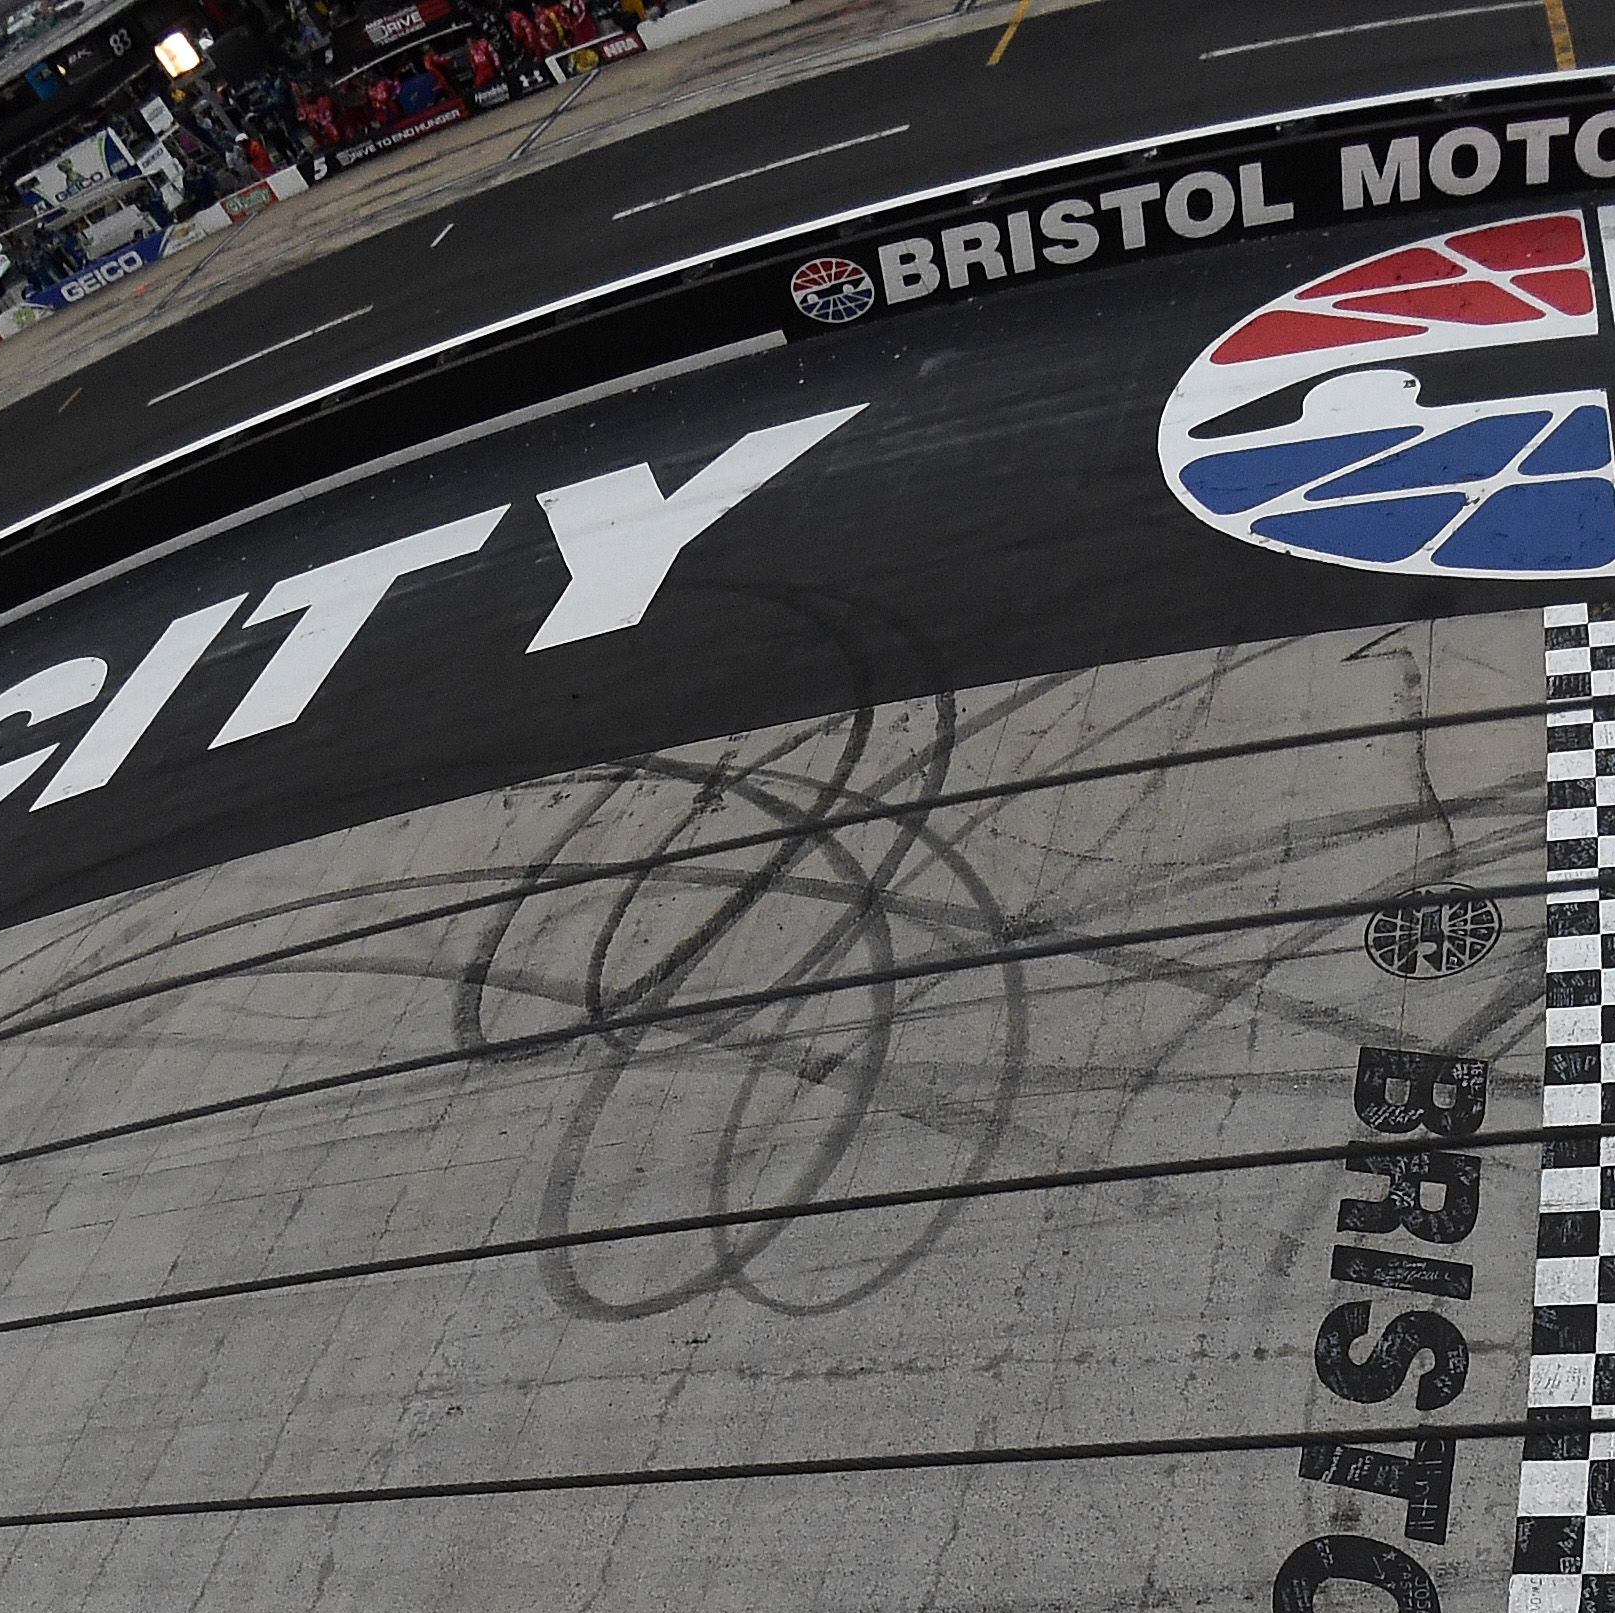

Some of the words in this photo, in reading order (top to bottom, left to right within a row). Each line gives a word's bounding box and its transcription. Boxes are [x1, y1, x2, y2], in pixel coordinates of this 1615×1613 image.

[377, 134, 392, 149] TO
[392, 126, 415, 144] END
[415, 108, 461, 134] HUNGER
[55, 171, 103, 202] GEICO
[878, 162, 1295, 305] BRISTOL
[61, 250, 144, 302] GEICO
